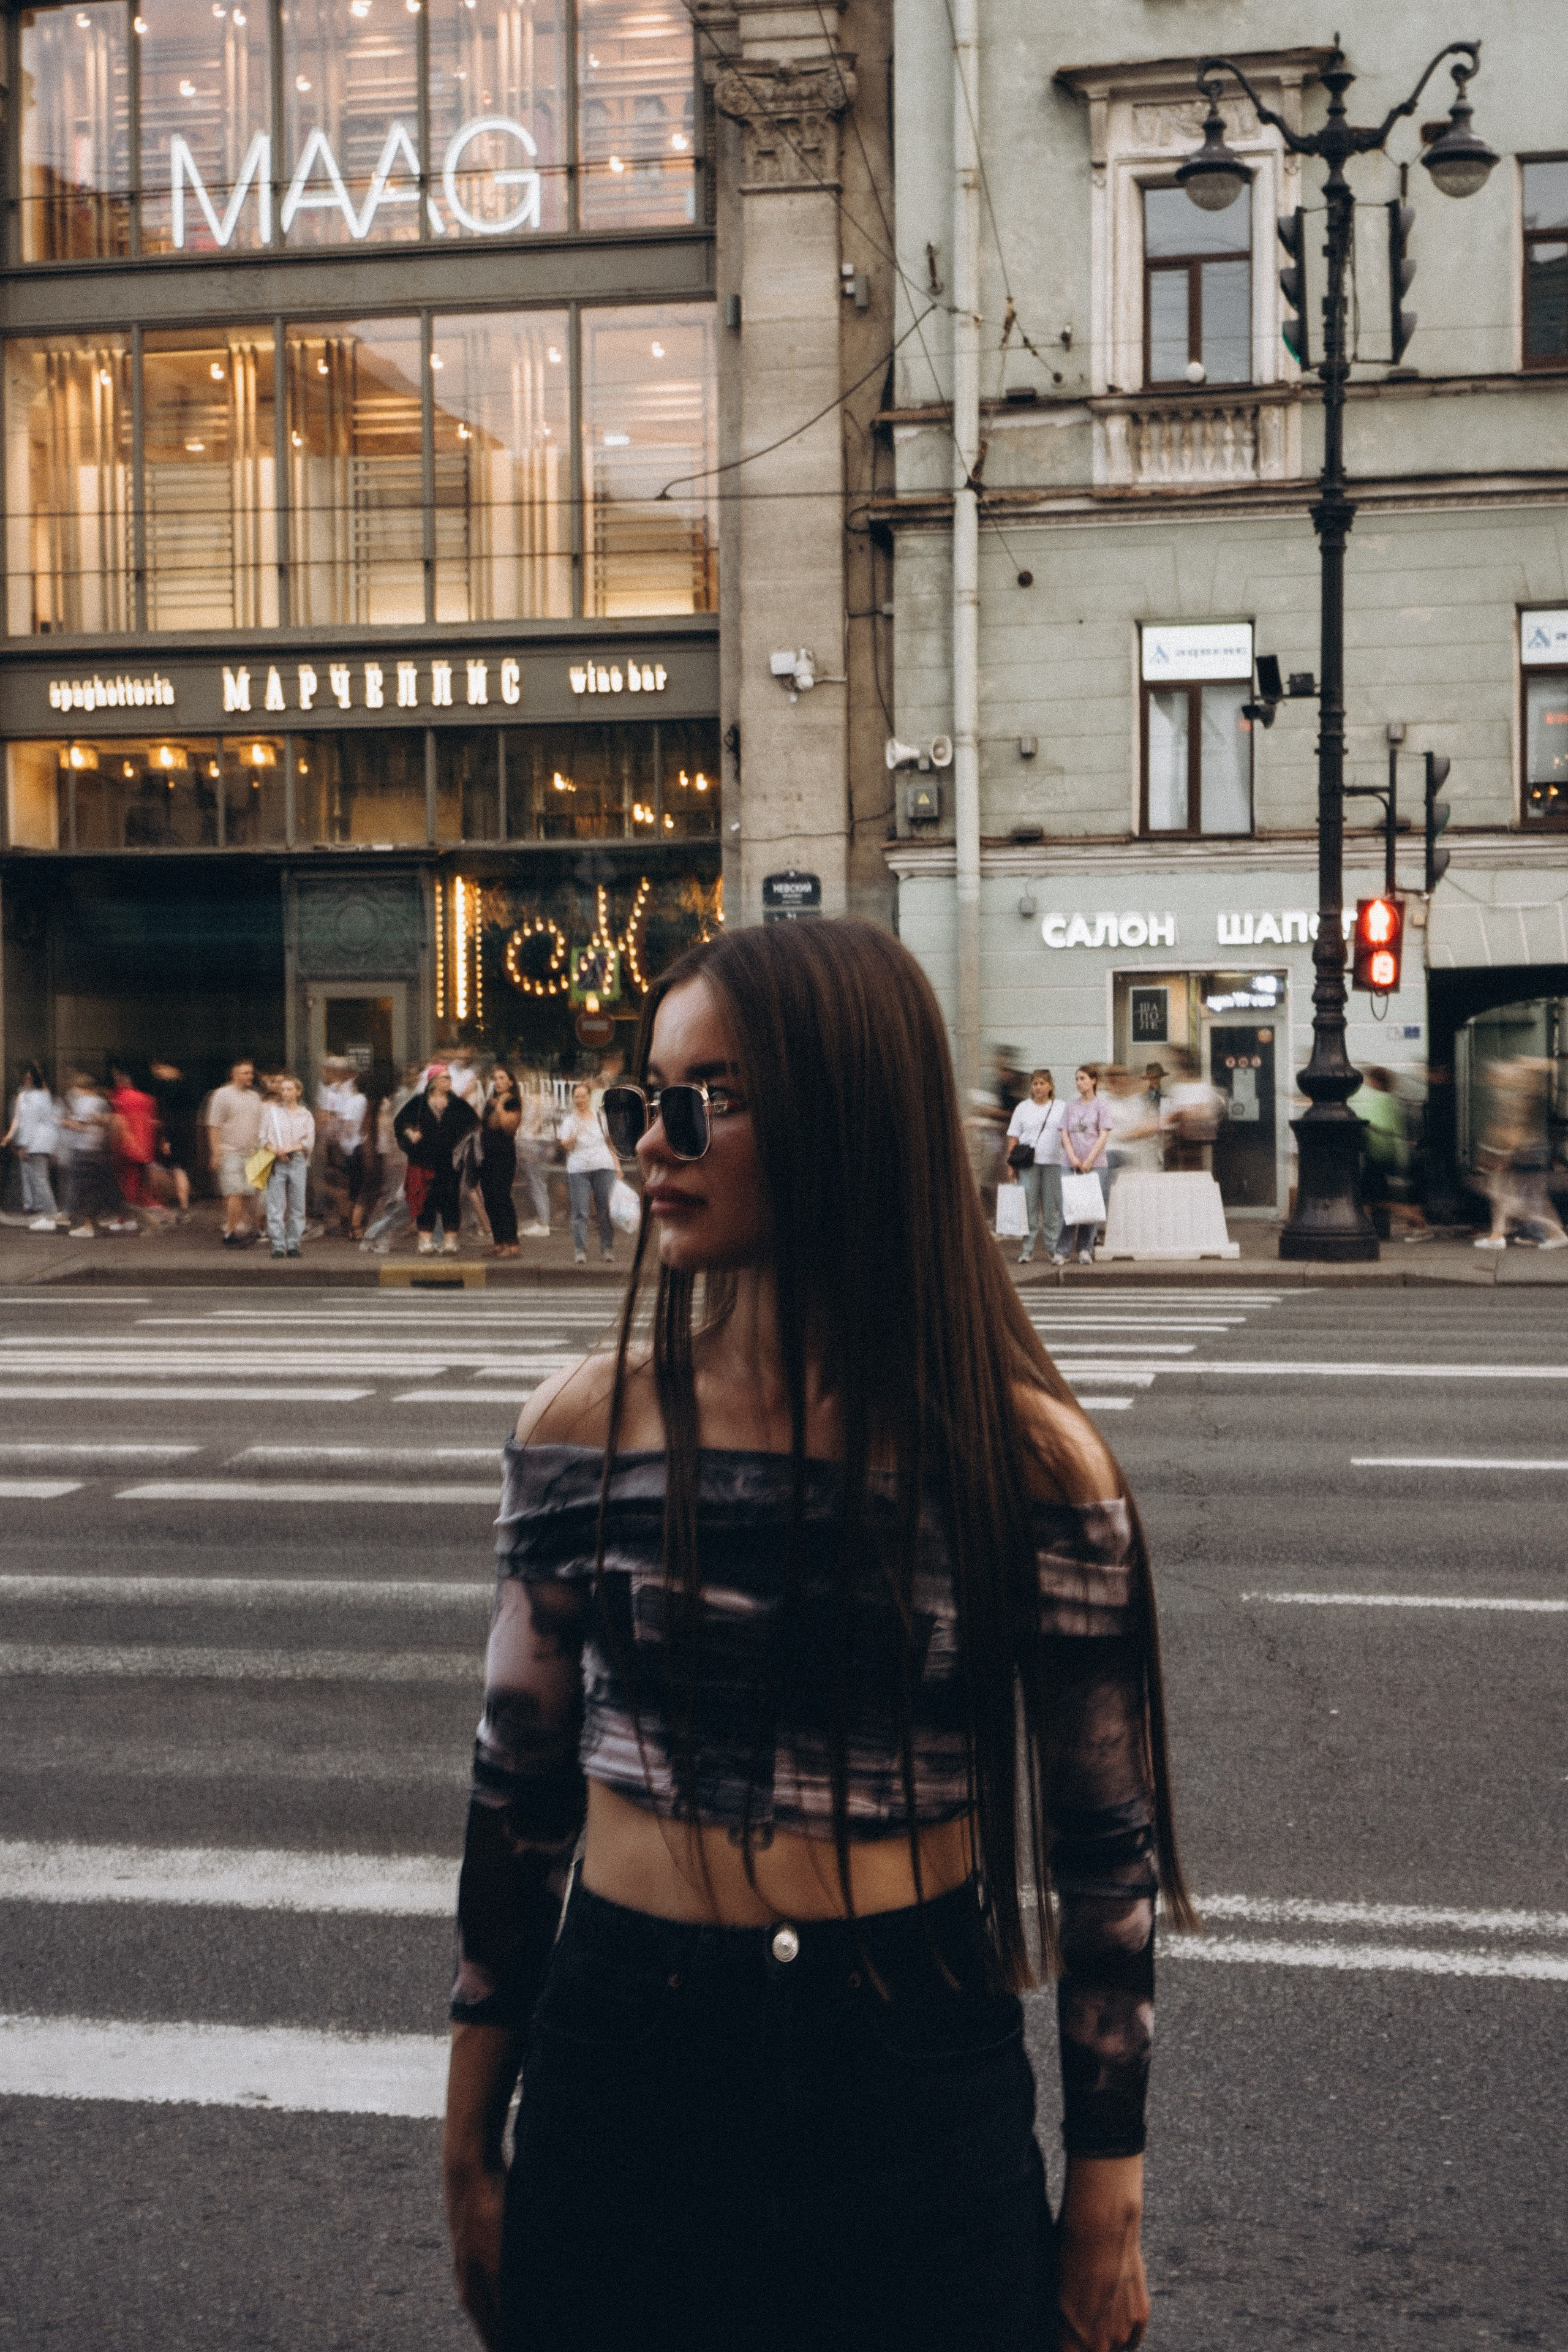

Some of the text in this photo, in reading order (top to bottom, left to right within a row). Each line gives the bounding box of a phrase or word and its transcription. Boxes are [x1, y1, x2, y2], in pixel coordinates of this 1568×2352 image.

[171, 115, 541, 249] MAAG
[50, 673, 175, 712] spaghetteria
[222, 658, 521, 712] МАРЧЕЛЛИС
[570, 658, 667, 693] wine bar
[1041, 913, 1175, 948] САЛОН
